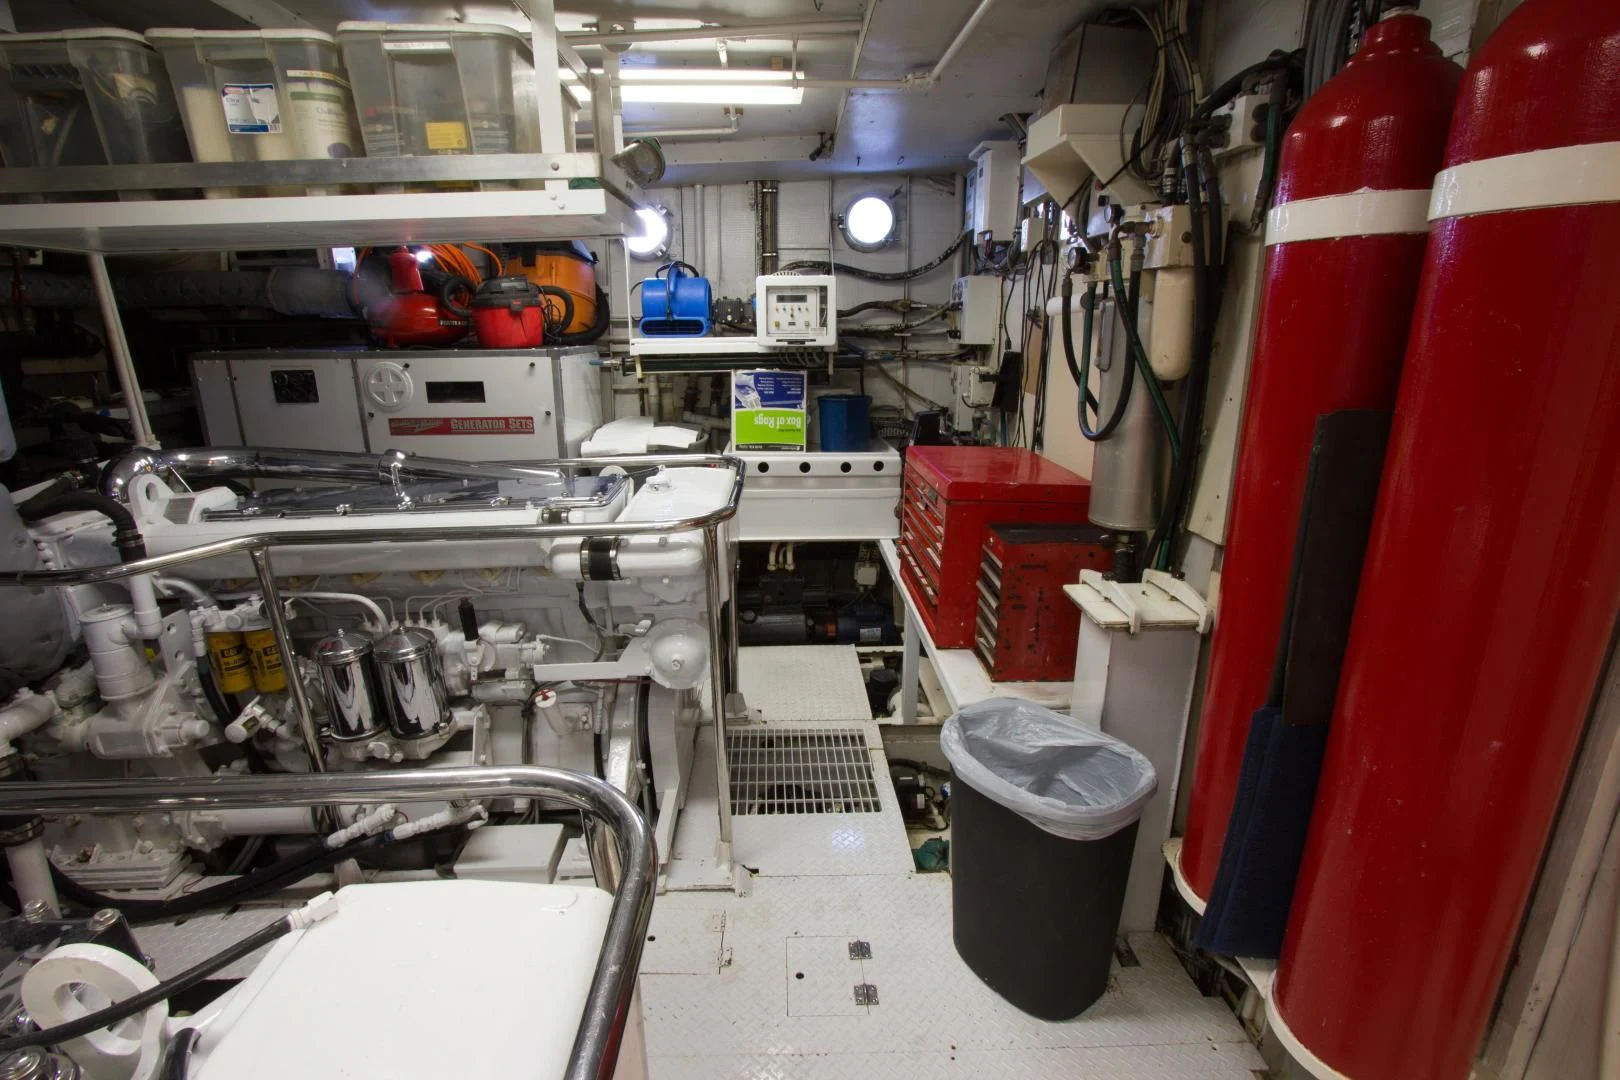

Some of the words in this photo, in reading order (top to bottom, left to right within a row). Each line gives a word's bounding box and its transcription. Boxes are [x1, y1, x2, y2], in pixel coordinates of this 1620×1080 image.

[450, 418, 505, 430] GENERATOR
[508, 418, 533, 429] SETS
[755, 413, 774, 428] Rags
[776, 416, 785, 428] of
[787, 416, 801, 428] Box
